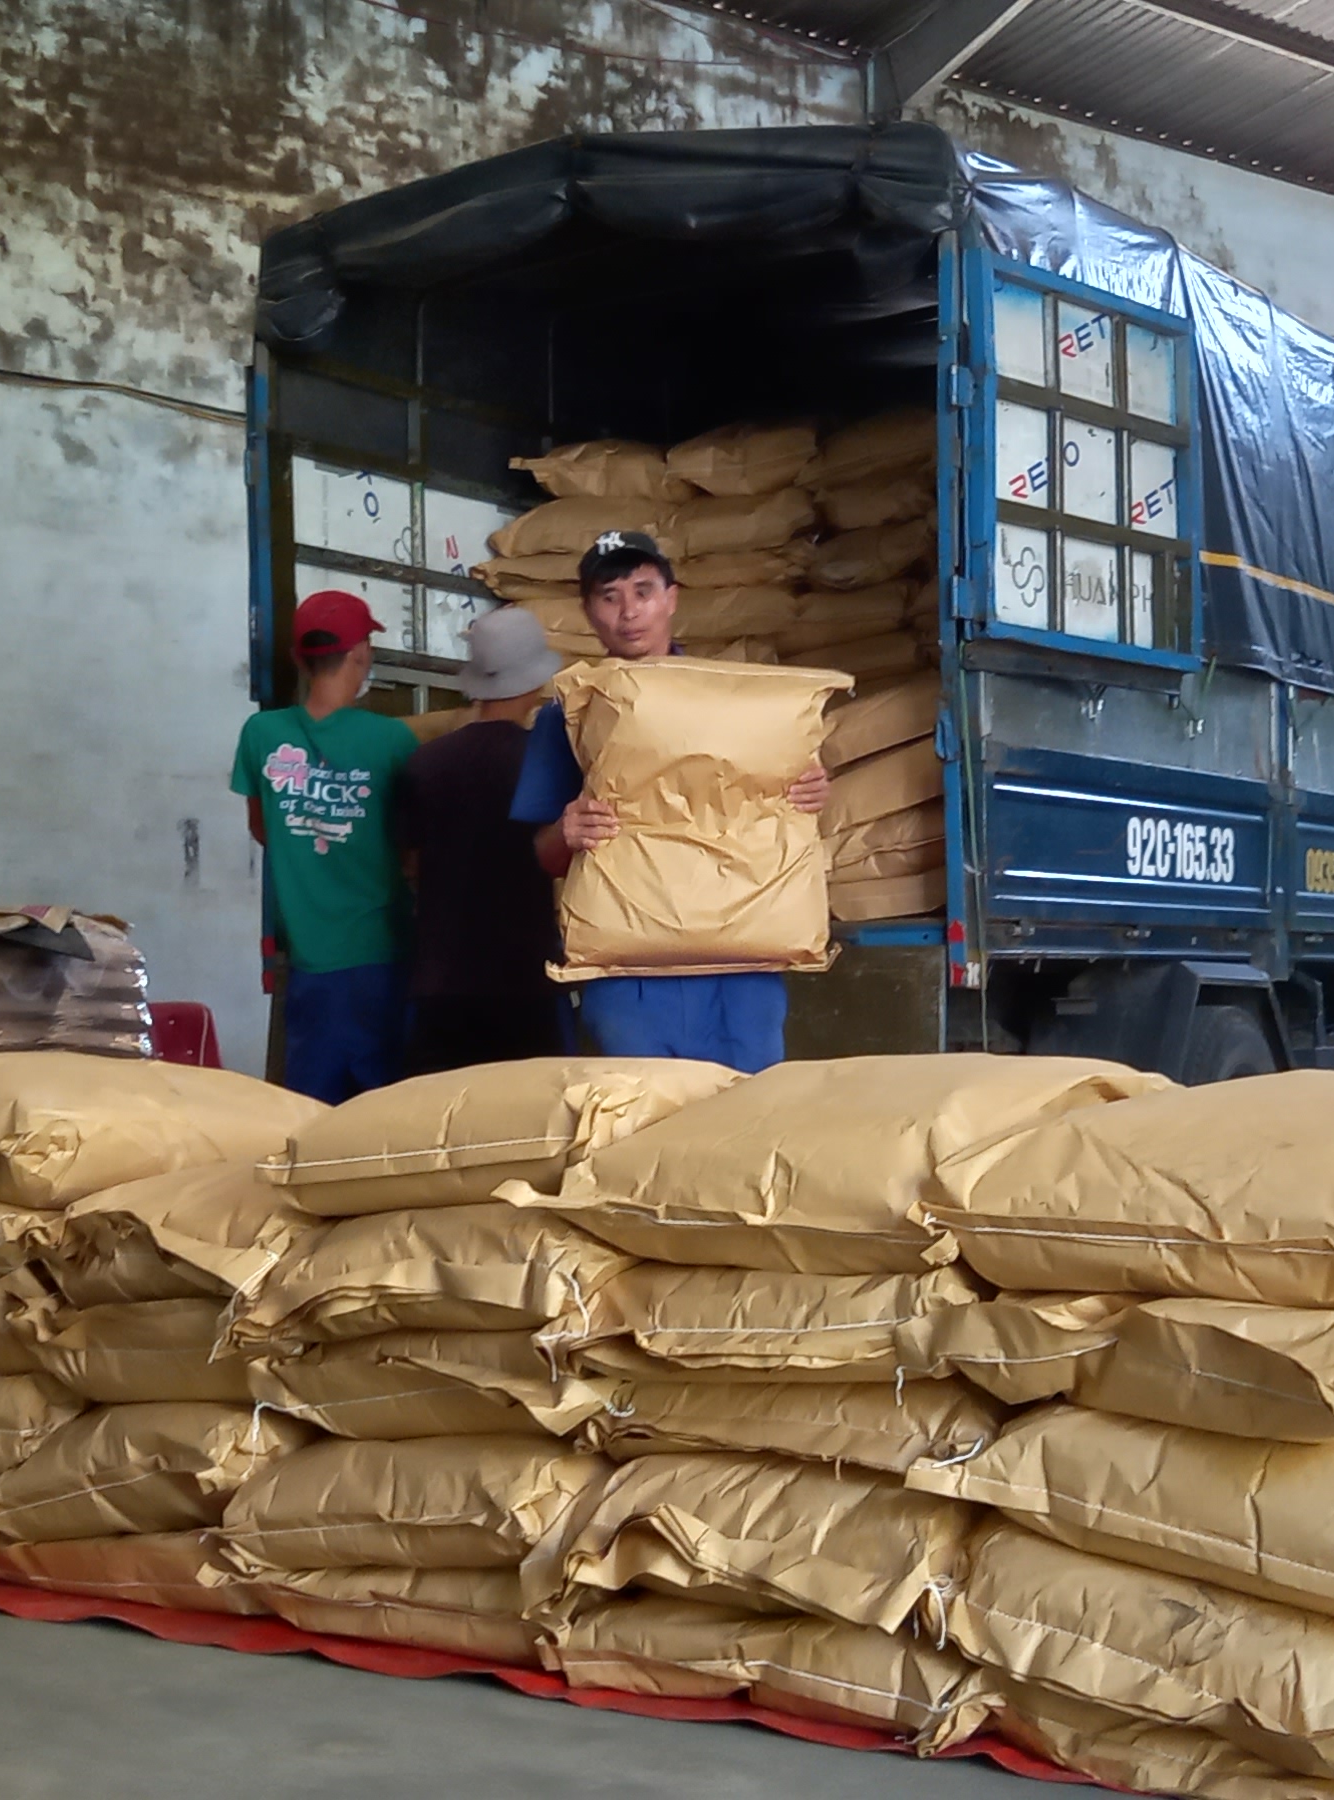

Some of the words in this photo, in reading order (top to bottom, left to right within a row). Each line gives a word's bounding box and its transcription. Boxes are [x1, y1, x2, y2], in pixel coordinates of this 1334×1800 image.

[1058, 312, 1109, 358] RET
[1008, 440, 1080, 499] REO
[1131, 478, 1175, 525] RET
[287, 776, 358, 803] LUCK
[1127, 816, 1234, 883] 92C-165.33
